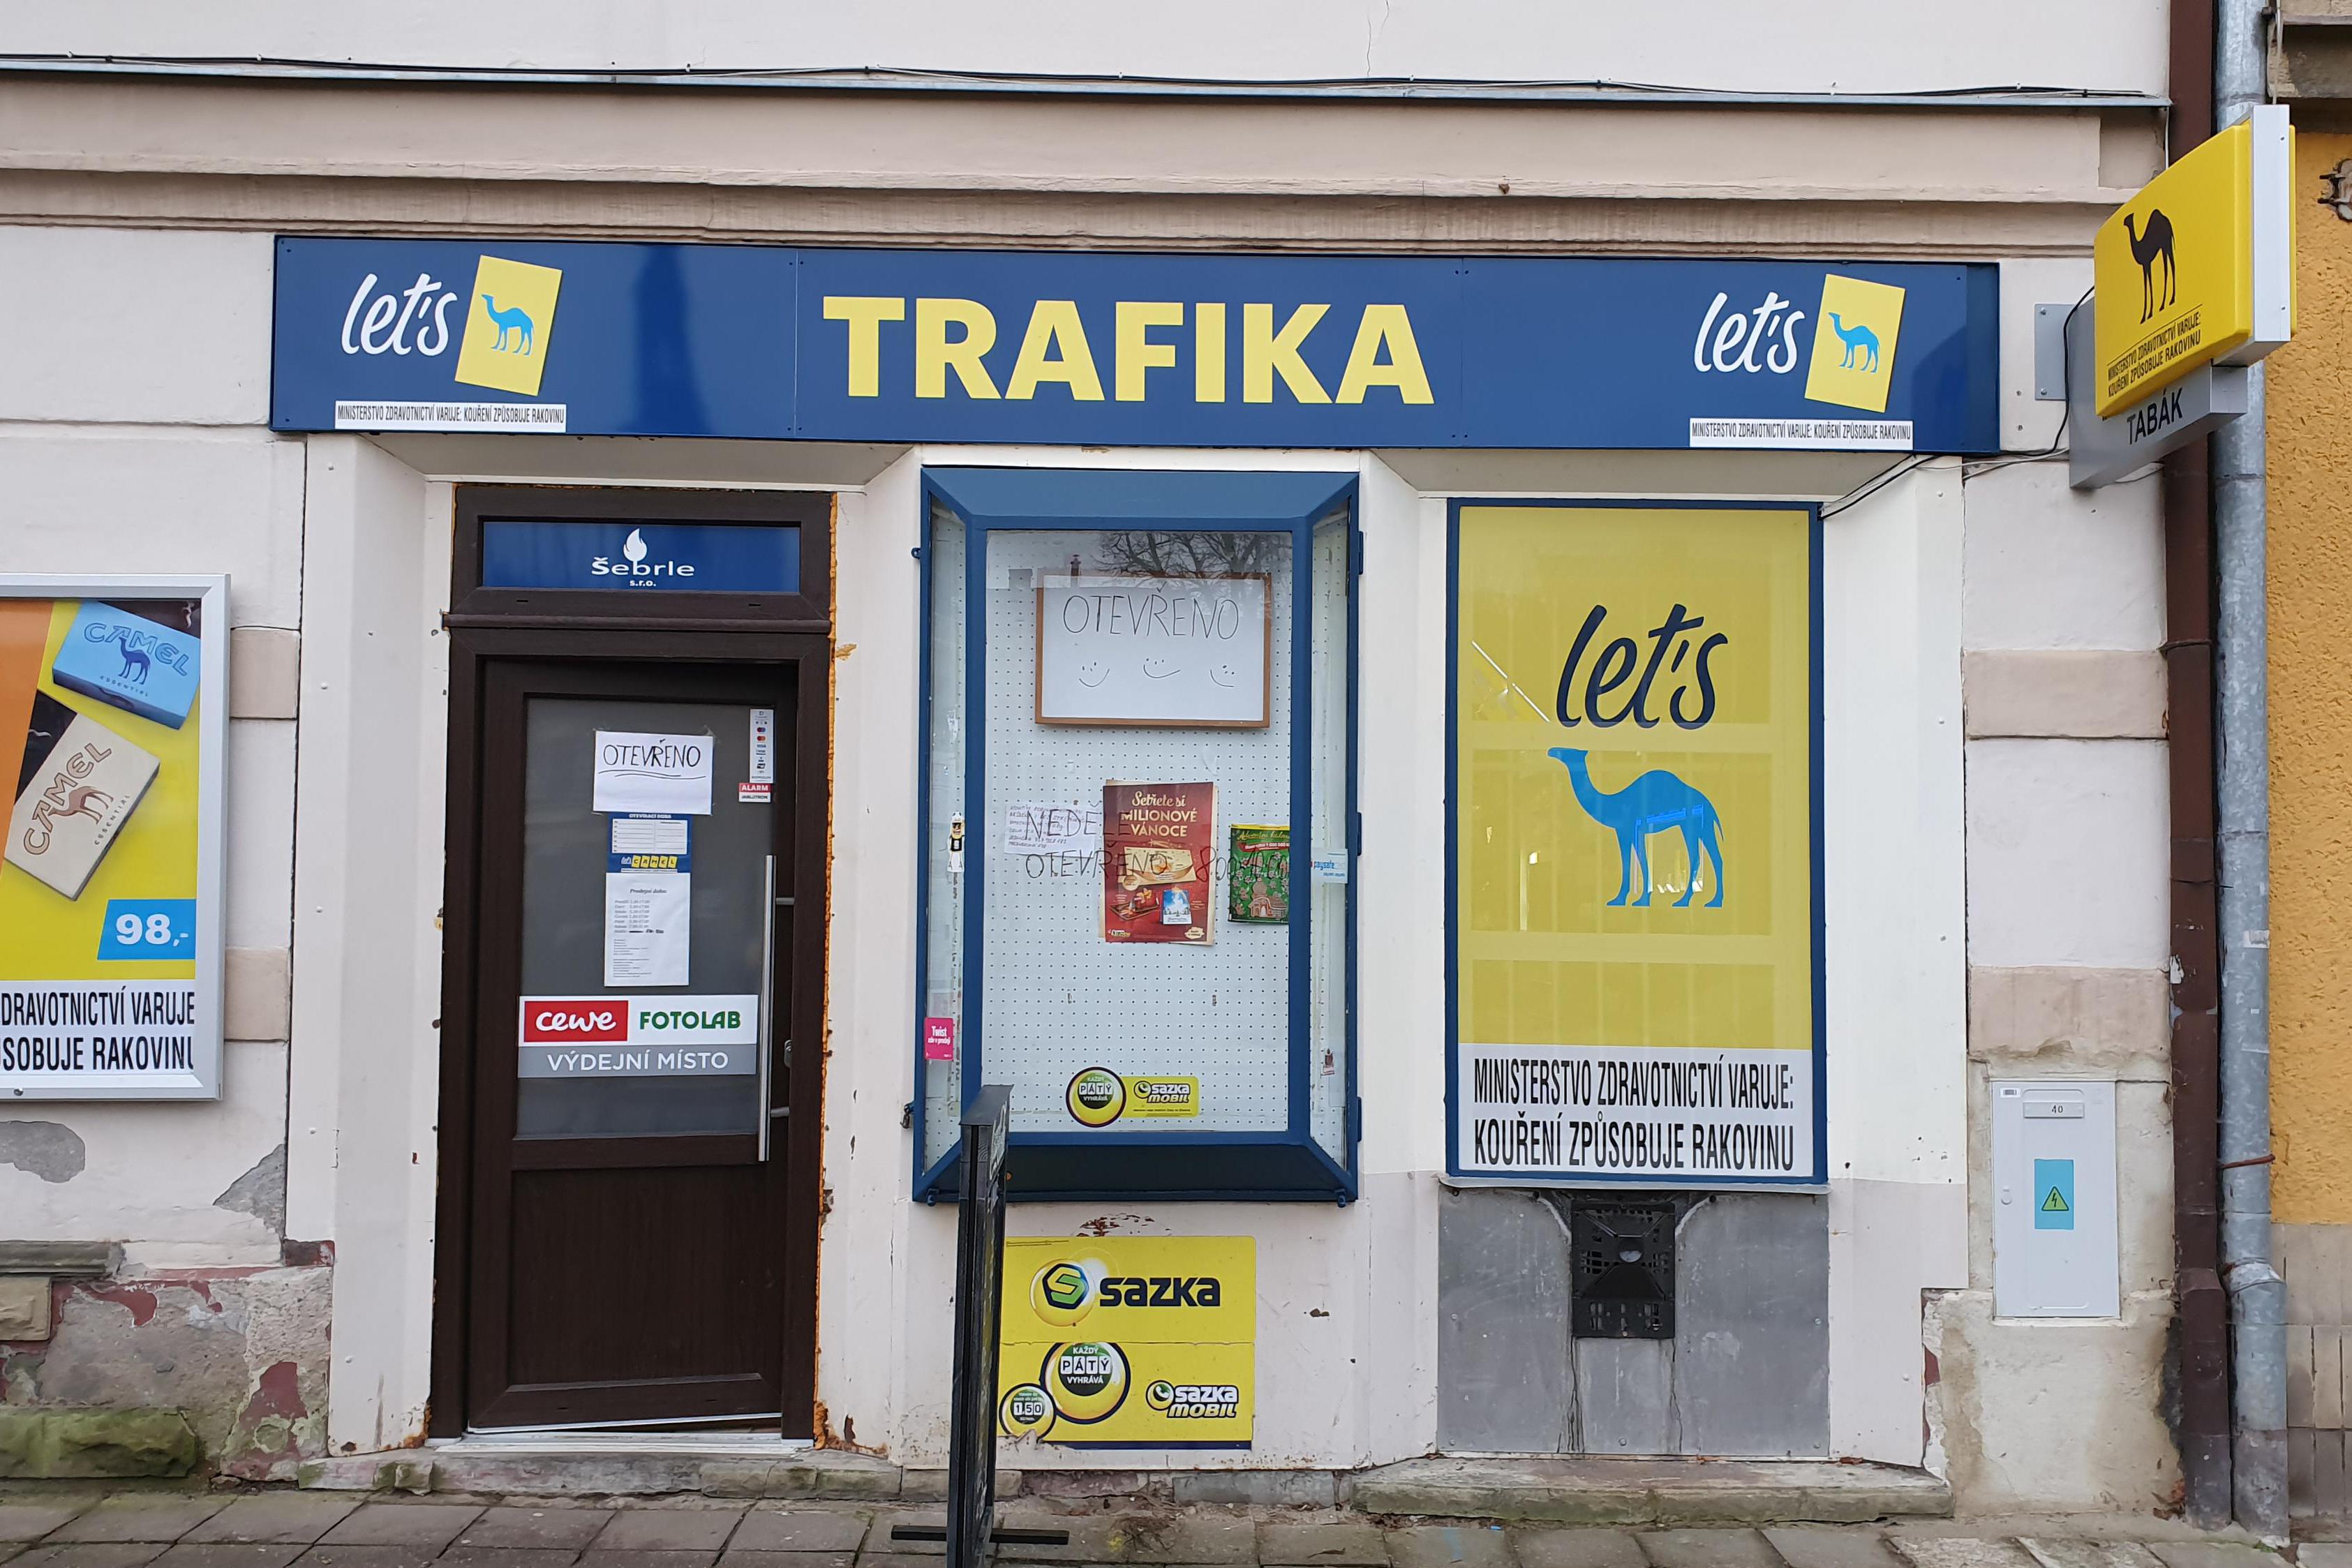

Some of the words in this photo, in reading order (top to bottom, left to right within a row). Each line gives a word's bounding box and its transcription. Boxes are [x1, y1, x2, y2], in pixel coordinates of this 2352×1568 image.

[341, 273, 457, 357] let's
[1694, 291, 1806, 374] let's
[2165, 329, 2201, 361] RAKOVINU
[823, 296, 1435, 404] TRAFIKA
[2108, 350, 2137, 381] STERSTVO
[338, 405, 383, 420] MINISTERSTVO
[385, 404, 436, 421] ZDRAVOTNICTVÍ
[463, 405, 493, 422] KOUŘENÍ
[493, 405, 530, 423] ZPŮSOBUJE
[532, 408, 564, 424] RAKOVINU
[2127, 387, 2183, 445] TABÁK
[1692, 423, 1736, 438] MINISTERSTVO
[1739, 421, 1786, 438] ZDRAVOTNICTVÍ
[1814, 421, 1842, 439] KOUŘENÍ
[1843, 424, 1877, 440] ZPŮSOBUJE
[1880, 425, 1910, 440] RAKOVINU
[591, 556, 695, 576] Šebrle
[1064, 581, 1239, 640] OTEVŘENO
[84, 622, 188, 676] CAMEL
[1556, 603, 1728, 730] let's
[603, 738, 701, 768] OTEVŘENO
[24, 742, 112, 856] CAMEL
[1121, 807, 1198, 822] MILIONOVÉ
[1131, 821, 1188, 837] VÁNOCE
[1025, 840, 1168, 879] OTEVŘENO
[116, 913, 189, 947] 98,-
[1, 985, 127, 1026] DRAVOTNICTVÍ
[131, 991, 195, 1026] VARUJE
[535, 1011, 617, 1032] cewe
[639, 1010, 741, 1030] FOTOLAB
[0, 1036, 84, 1072] SOBUJE
[547, 1050, 651, 1071] VÝDEJNÍ
[657, 1049, 729, 1070] MÍSTO
[1081, 1083, 1112, 1093] PÁTÝ
[1474, 1058, 1591, 1107] MINISTERSTVO
[1597, 1054, 1725, 1109] ZDRAVOTNICTVÍ
[1728, 1063, 1794, 1110] VARUJE:
[2051, 1105, 2064, 1114] 40
[1474, 1110, 1563, 1167] KOUŘENÍ
[1569, 1110, 1684, 1169] ZPŮSOBUJE
[1692, 1123, 1794, 1171] RAKOVINU
[1062, 1357, 1110, 1371] PÁTÝ
[1073, 1345, 1099, 1354] KAŽDÝ
[1066, 1375, 1104, 1384] VYHRÁVÁ
